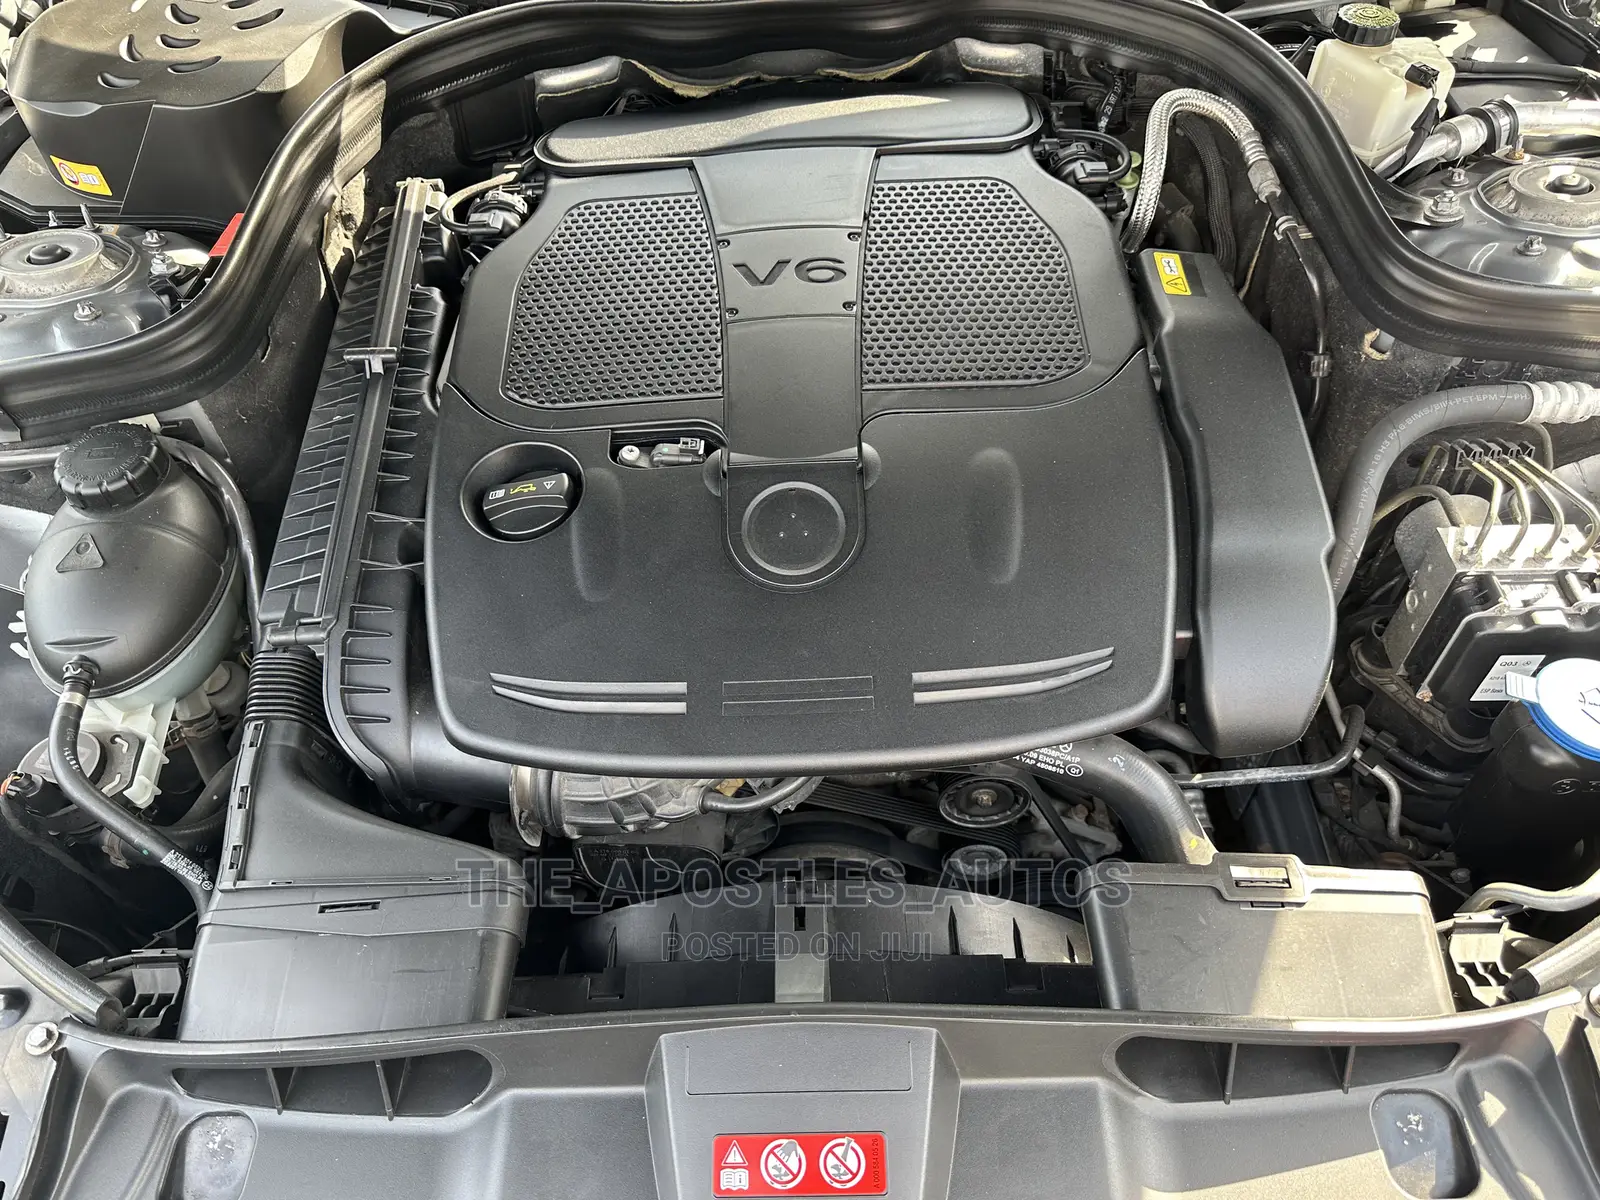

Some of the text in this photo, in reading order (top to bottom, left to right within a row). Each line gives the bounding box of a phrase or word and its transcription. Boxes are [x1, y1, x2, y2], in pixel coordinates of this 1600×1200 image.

[732, 257, 846, 287] V6
[1020, 756, 1036, 765] YAP
[1055, 760, 1065, 768] PL
